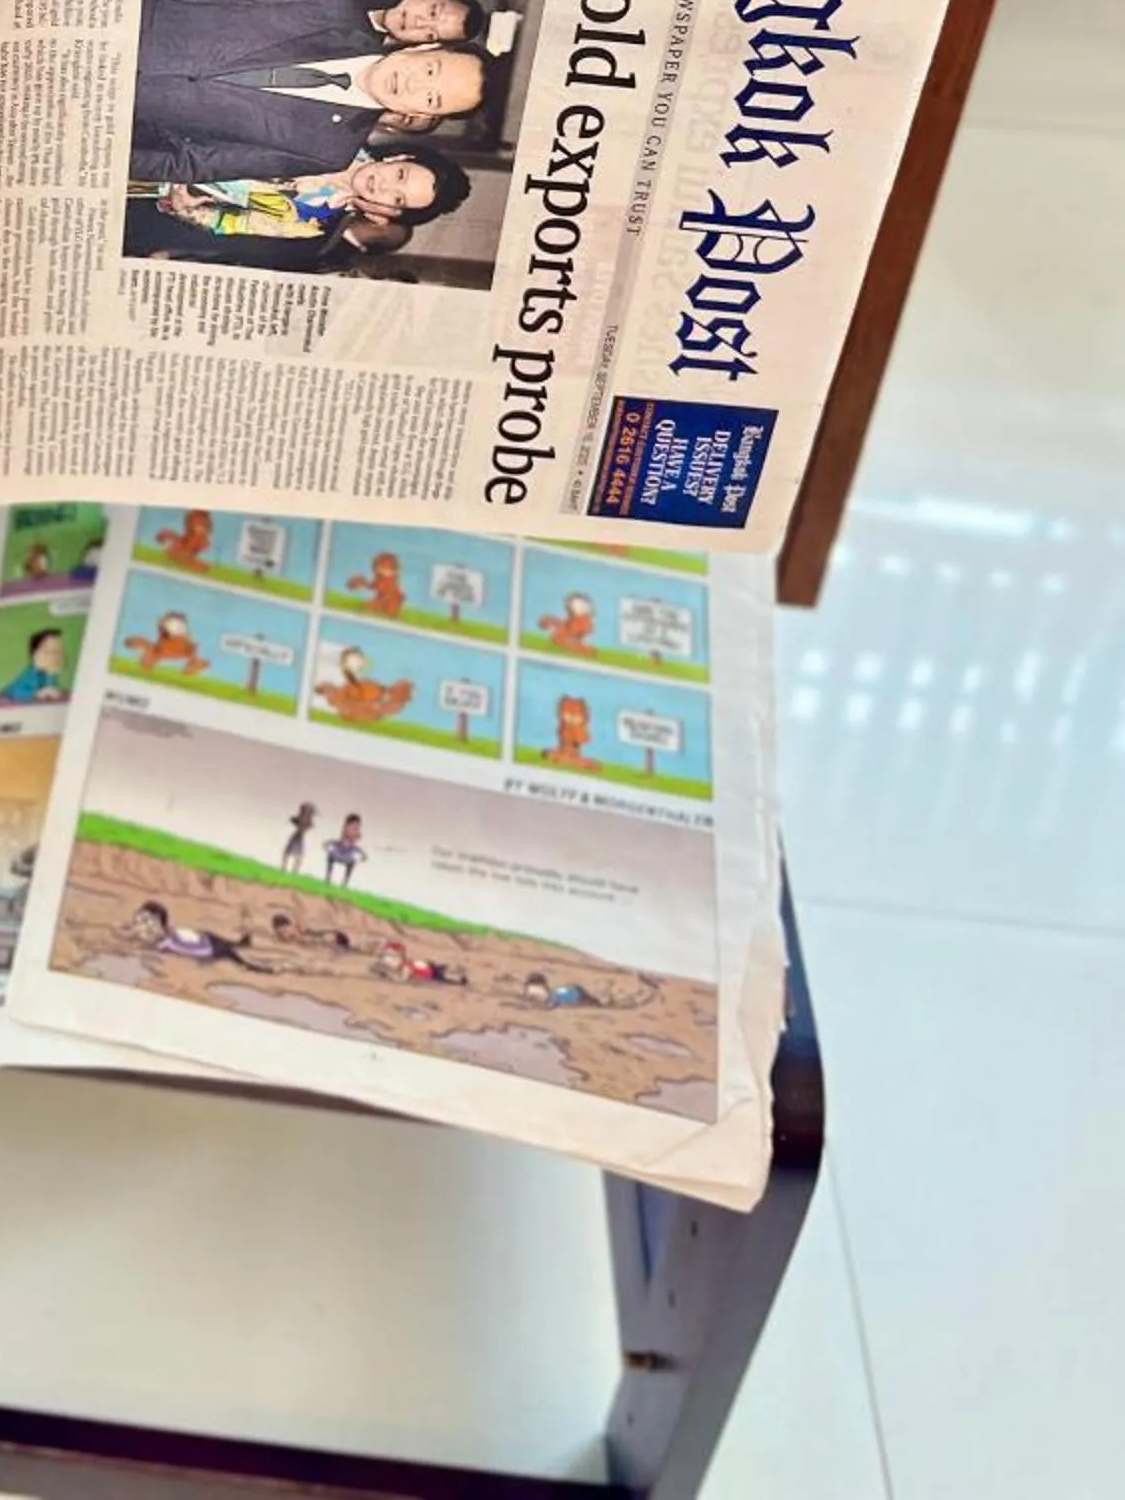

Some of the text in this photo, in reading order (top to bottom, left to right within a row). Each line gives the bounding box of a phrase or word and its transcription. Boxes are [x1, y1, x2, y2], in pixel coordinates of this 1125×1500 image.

[650, 92, 673, 127] YOU
[640, 136, 661, 171] CAN
[518, 104, 607, 334] exports
[626, 180, 652, 237] TRUST
[667, 188, 817, 383] Post
[484, 344, 556, 506] probe
[614, 427, 637, 464] 2616
[626, 412, 640, 423] 0
[605, 469, 627, 504] 4444
[640, 419, 676, 504] QUESTION?
[660, 438, 689, 491] HAVE A
[682, 437, 712, 496] ISSUES?
[697, 430, 732, 504] DELIVERY
[721, 425, 764, 513] Bangkok Post
